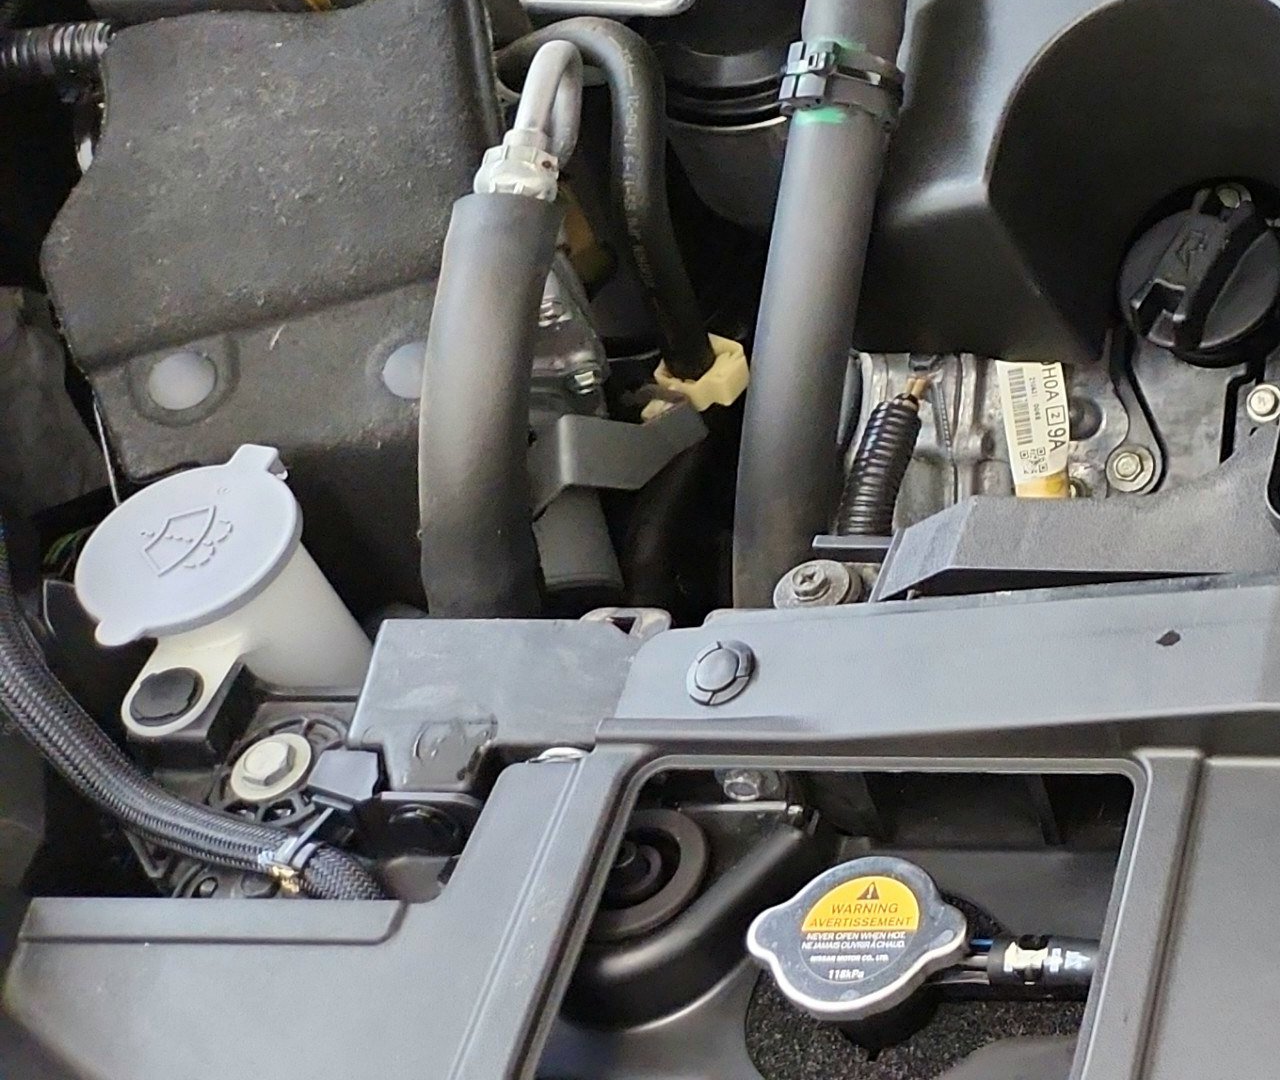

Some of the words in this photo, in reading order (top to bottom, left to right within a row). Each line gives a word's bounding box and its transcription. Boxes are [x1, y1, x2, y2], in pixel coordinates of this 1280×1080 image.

[1047, 428, 1067, 452] 9A
[831, 903, 898, 914] WARNING
[810, 917, 912, 927] AVERTISSEMENT
[806, 932, 835, 941] NEVER
[836, 932, 860, 941] OPEN
[861, 931, 886, 940] WHEN
[801, 941, 812, 950] NE
[812, 941, 840, 950] JAMAIS
[841, 941, 870, 949] OUVRIR
[837, 954, 861, 962] MOTOR
